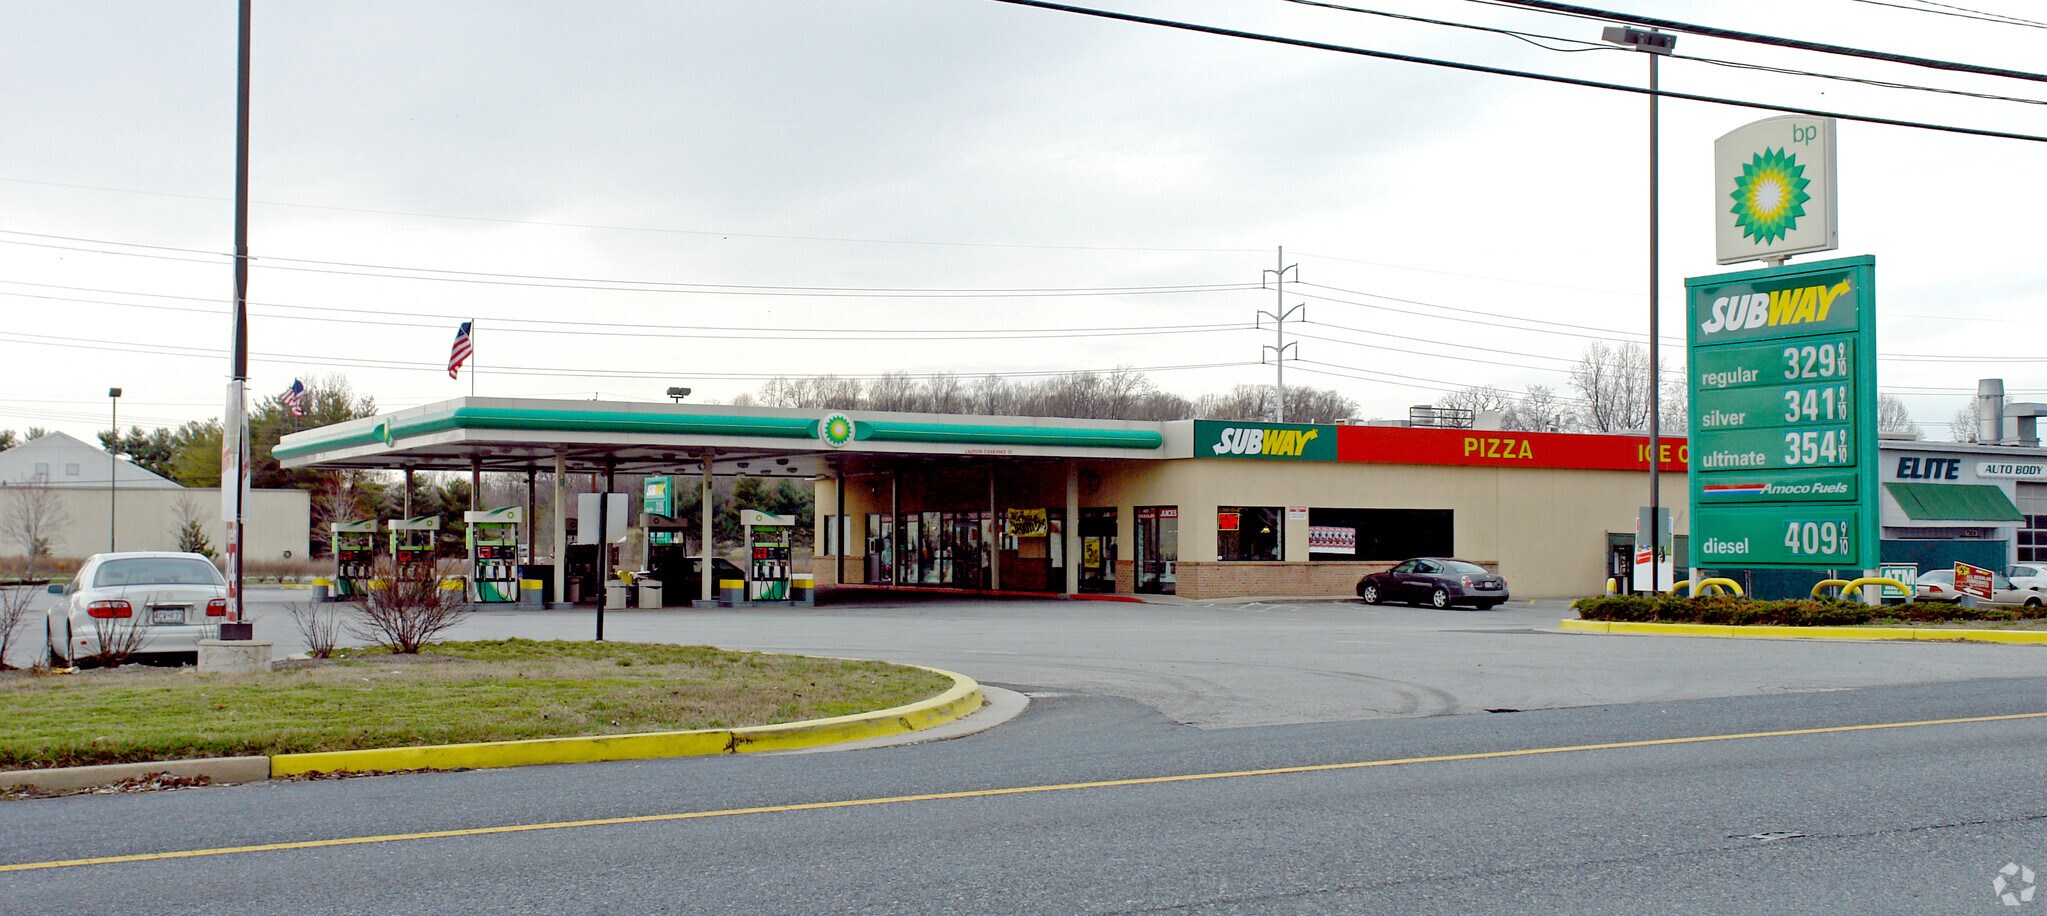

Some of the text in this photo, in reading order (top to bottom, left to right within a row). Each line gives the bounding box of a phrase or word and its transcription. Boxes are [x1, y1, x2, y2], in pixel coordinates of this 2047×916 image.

[1793, 123, 1817, 146] bp
[1701, 279, 1851, 336] SUBWAY
[1702, 367, 1758, 387] regular
[1783, 344, 1836, 379] 329
[1702, 410, 1746, 427] silver
[1784, 387, 1834, 423] 341
[1212, 427, 1319, 456] SUBWAY
[1464, 437, 1533, 460] PIZZA
[1702, 450, 1766, 467] ultimate
[1784, 430, 1836, 465] 354
[1896, 457, 1961, 480] ELITE
[1985, 464, 2043, 475] AUTO BODY
[1760, 481, 1848, 495] Amoco Fuels
[1160, 509, 1177, 517] JUICES
[1703, 537, 1749, 554] diesel
[1784, 521, 1838, 555] 409
[1884, 569, 1915, 585] ATM
